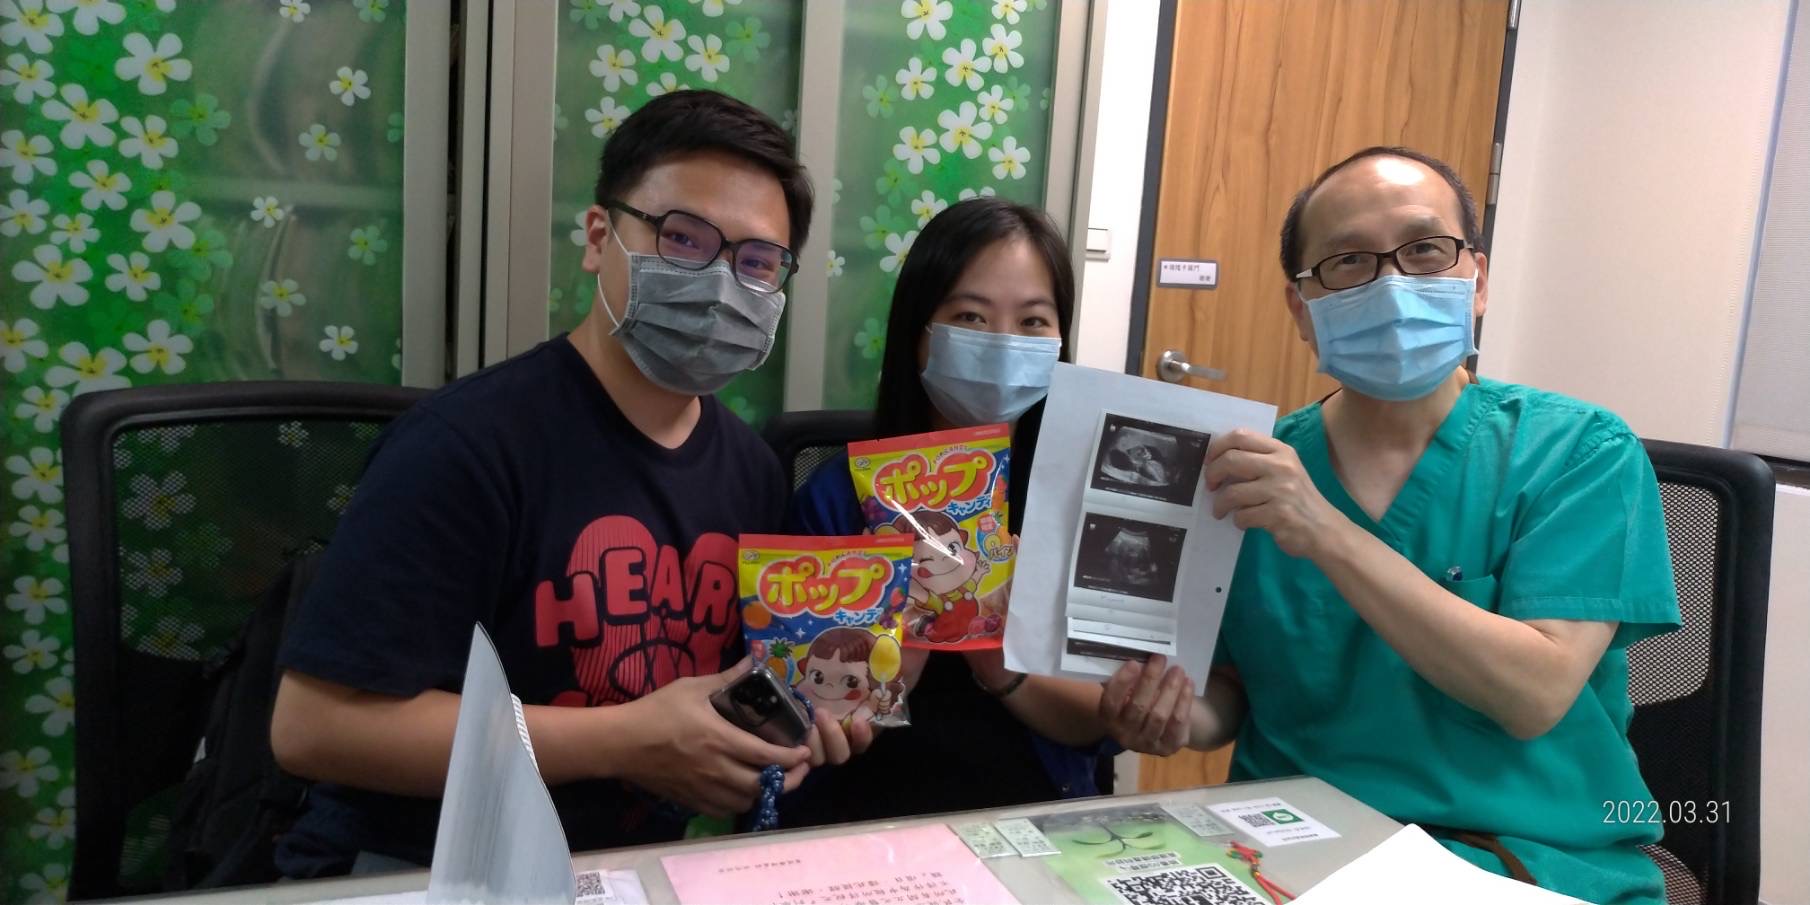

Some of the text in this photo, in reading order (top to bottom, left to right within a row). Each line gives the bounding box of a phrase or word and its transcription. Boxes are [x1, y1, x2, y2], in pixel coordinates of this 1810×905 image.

[880, 456, 988, 506] ポップ
[947, 494, 992, 514] キャンディ
[535, 544, 736, 648] HEAR
[767, 562, 885, 611] ポップ
